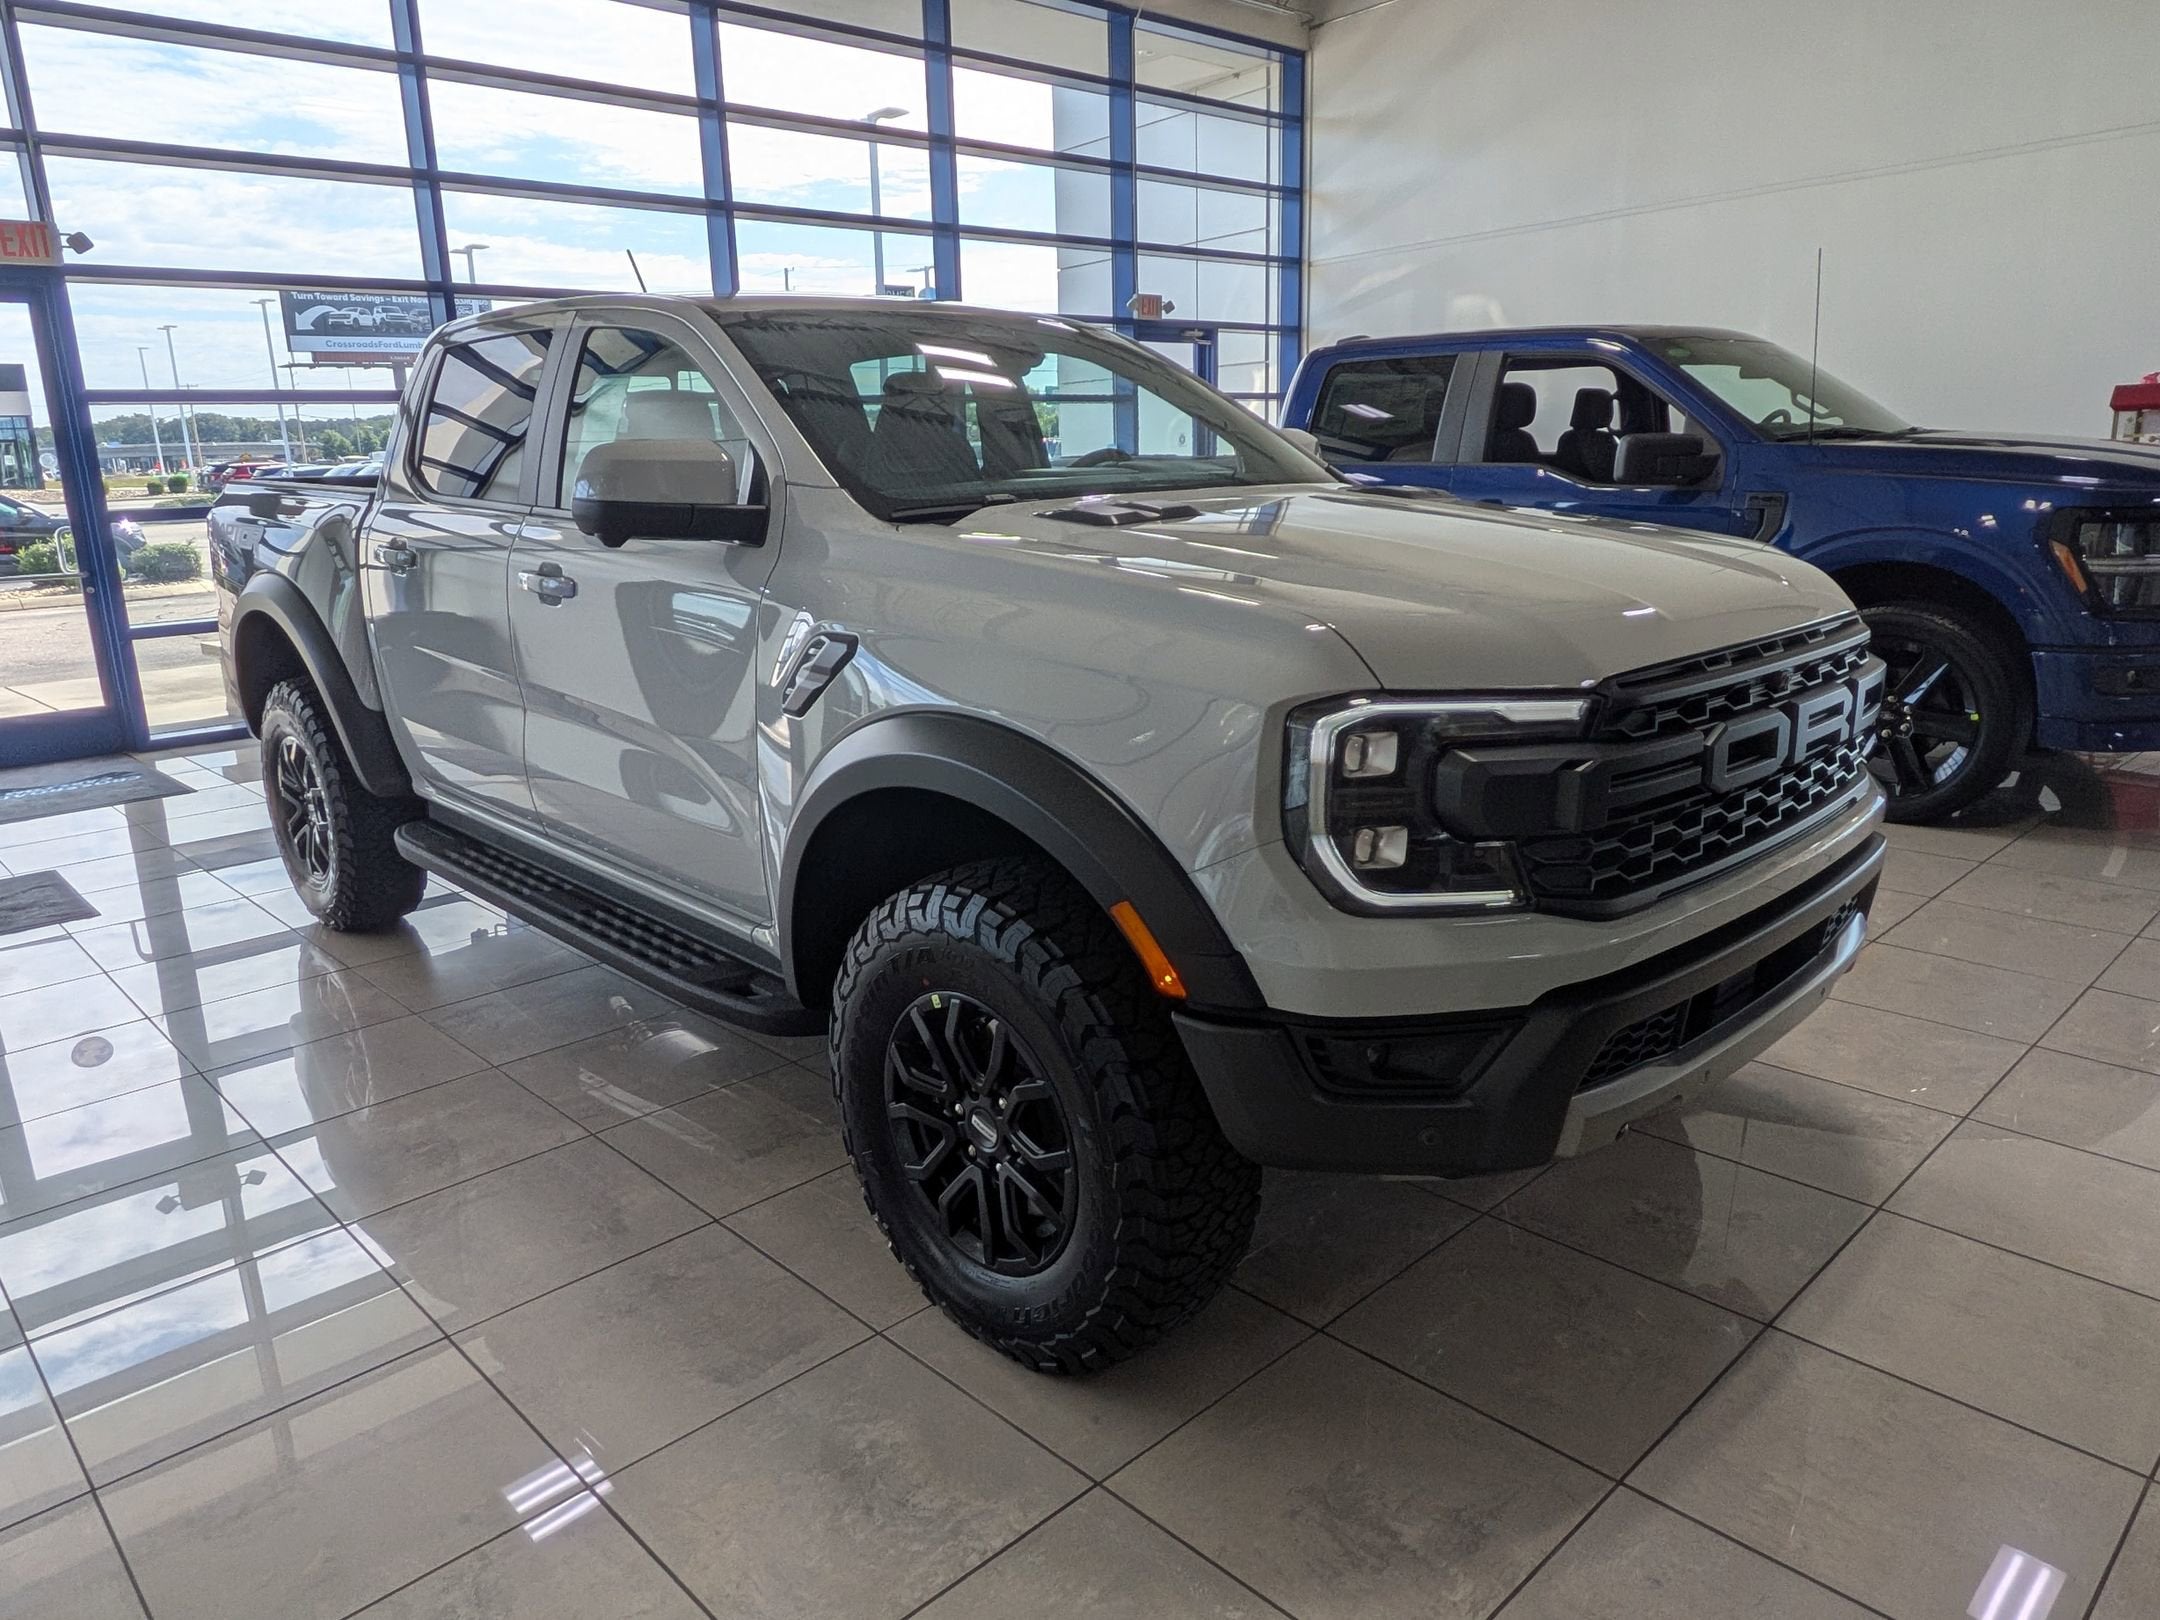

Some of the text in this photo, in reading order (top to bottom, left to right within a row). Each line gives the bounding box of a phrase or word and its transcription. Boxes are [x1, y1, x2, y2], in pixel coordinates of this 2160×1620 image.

[0, 223, 50, 258] EXIT
[291, 291, 314, 300] Turn
[314, 292, 349, 301] Toward
[349, 294, 385, 304] Savings
[392, 295, 410, 304] Exit
[1141, 297, 1160, 316] EXIT
